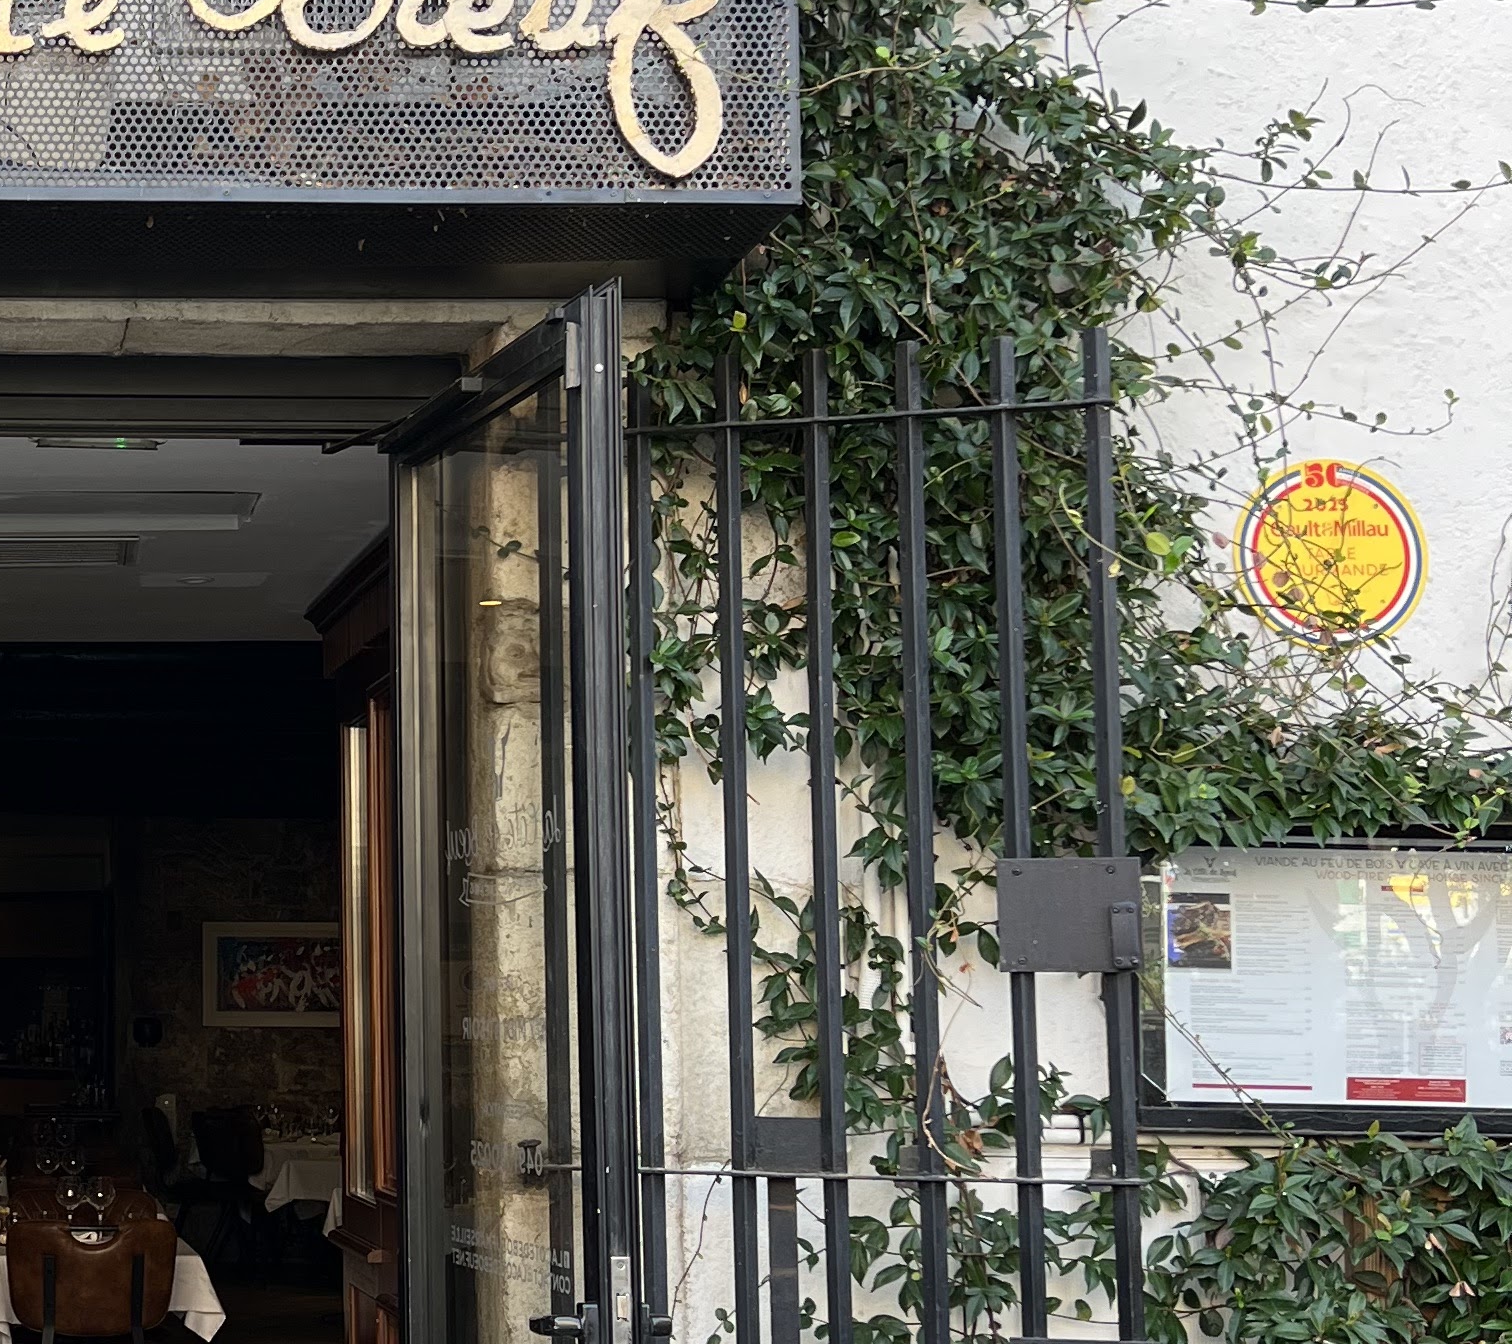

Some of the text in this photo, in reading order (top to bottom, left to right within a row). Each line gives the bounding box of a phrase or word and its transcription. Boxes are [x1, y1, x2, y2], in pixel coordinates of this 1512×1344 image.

[1301, 857, 1318, 868] AU
[1320, 858, 1344, 869] FEU
[1346, 858, 1362, 869] DE
[1365, 859, 1394, 870] BOIS
[1454, 861, 1474, 871] VIN
